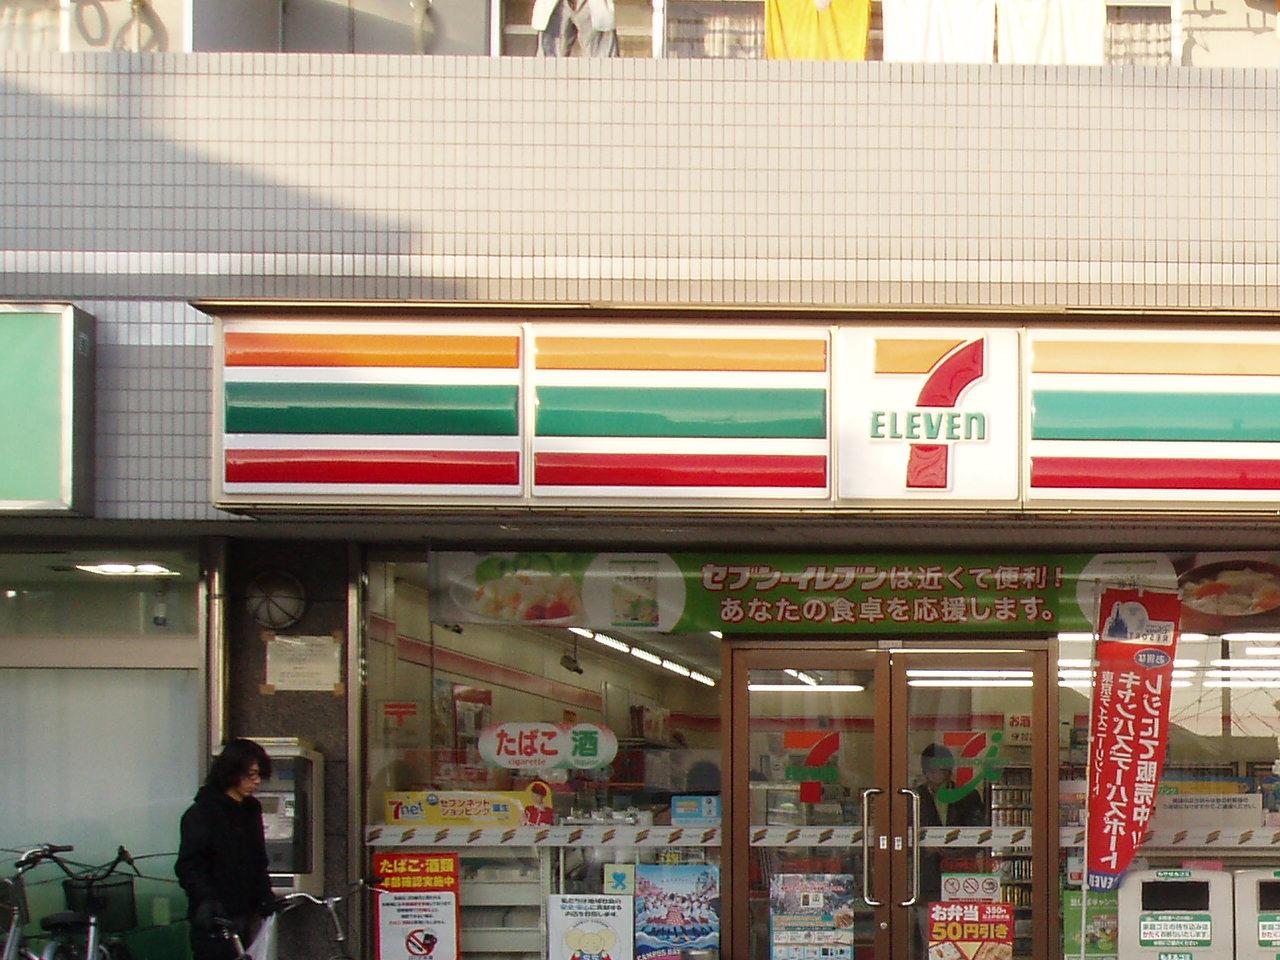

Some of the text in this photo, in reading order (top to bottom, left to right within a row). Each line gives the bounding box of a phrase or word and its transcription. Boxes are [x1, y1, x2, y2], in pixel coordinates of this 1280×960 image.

[875, 338, 984, 488] 7
[720, 597, 1056, 624] あなたの食卓を応援します。
[495, 729, 599, 758] たばこ 酒
[440, 799, 491, 808] セブンネット
[441, 807, 491, 817] ショッピング
[931, 904, 979, 922] お弁当
[932, 922, 1009, 941] 50円引き
